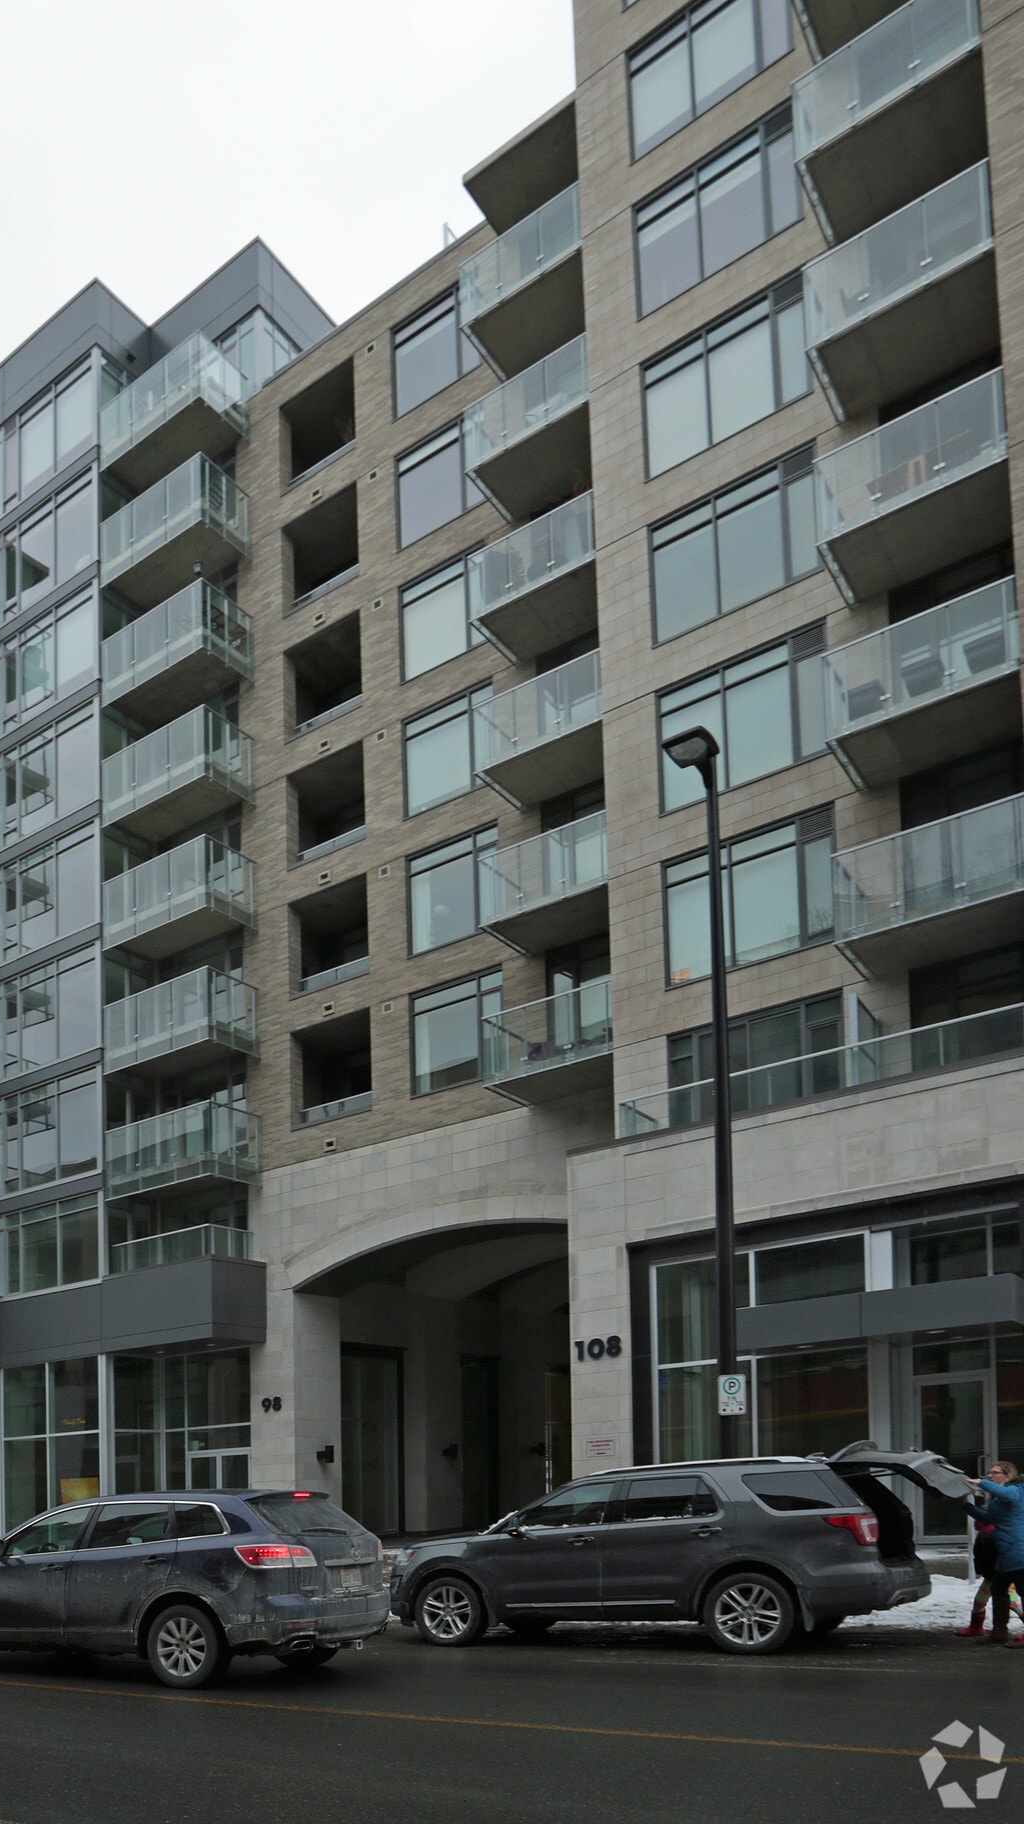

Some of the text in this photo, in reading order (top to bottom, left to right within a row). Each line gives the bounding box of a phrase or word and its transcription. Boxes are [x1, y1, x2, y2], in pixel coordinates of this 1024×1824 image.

[574, 1335, 623, 1362] 108
[728, 1381, 736, 1391] P
[261, 1396, 282, 1413] 98
